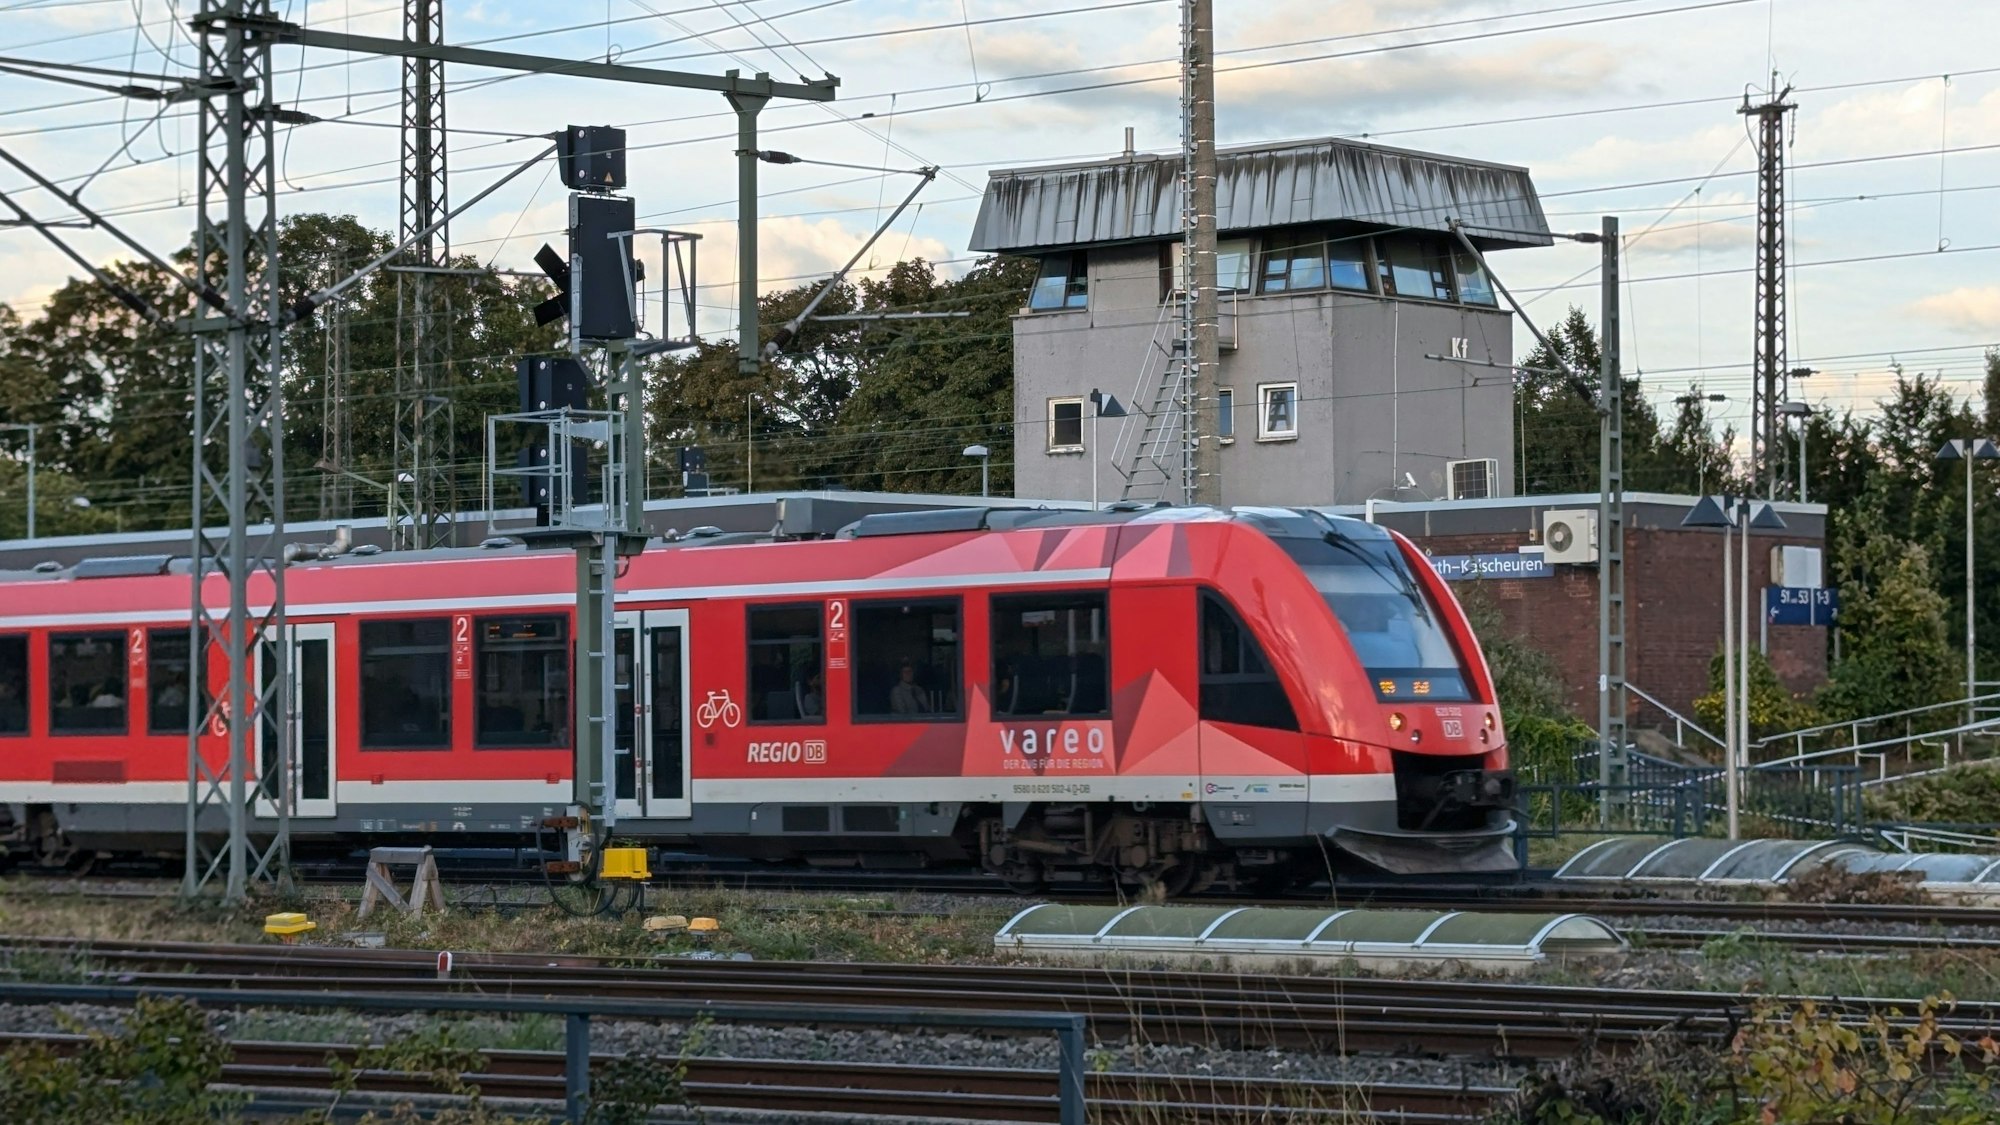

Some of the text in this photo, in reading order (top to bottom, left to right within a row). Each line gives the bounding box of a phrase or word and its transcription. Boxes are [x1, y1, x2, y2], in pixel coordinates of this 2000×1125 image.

[1452, 337, 1468, 359] Kf
[1780, 589, 1790, 604] 51
[1798, 590, 1809, 604] 53
[1816, 590, 1830, 605] 1-3
[830, 601, 843, 628] 2
[456, 617, 468, 642] 2
[132, 629, 142, 653] 2
[1444, 721, 1462, 736] DB
[1000, 728, 1103, 754] vareo
[747, 742, 825, 763] REGIO DB
[1003, 757, 1104, 770] DER ZUG FÜR DIE REGION
